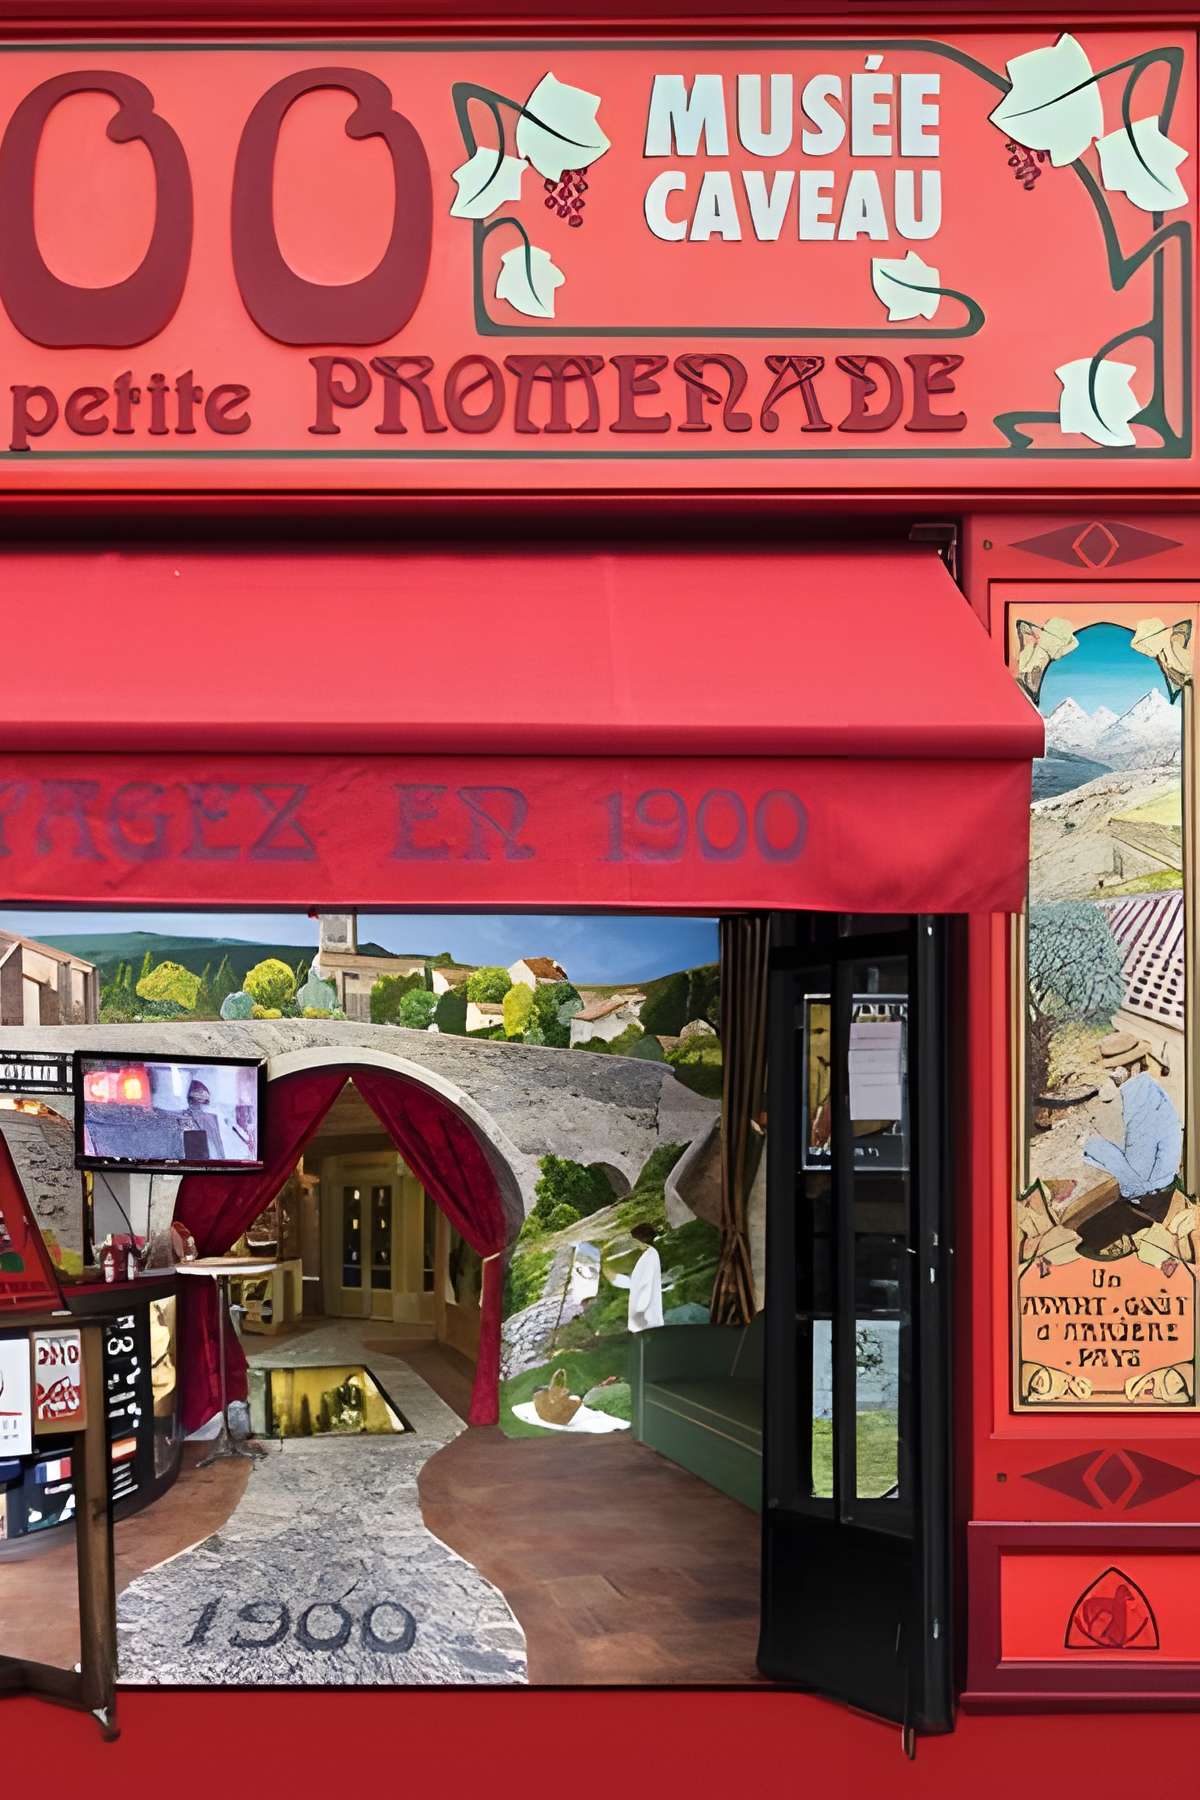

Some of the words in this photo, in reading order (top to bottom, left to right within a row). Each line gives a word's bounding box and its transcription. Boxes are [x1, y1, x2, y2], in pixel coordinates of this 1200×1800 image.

[643, 54, 941, 157] MUSÉE
[644, 170, 942, 242] CAVEAU
[9, 370, 251, 451] petite
[308, 354, 968, 434] PROMENADE
[390, 784, 536, 862] EN
[600, 787, 810, 864] 1900
[184, 1597, 417, 1653] 1900
